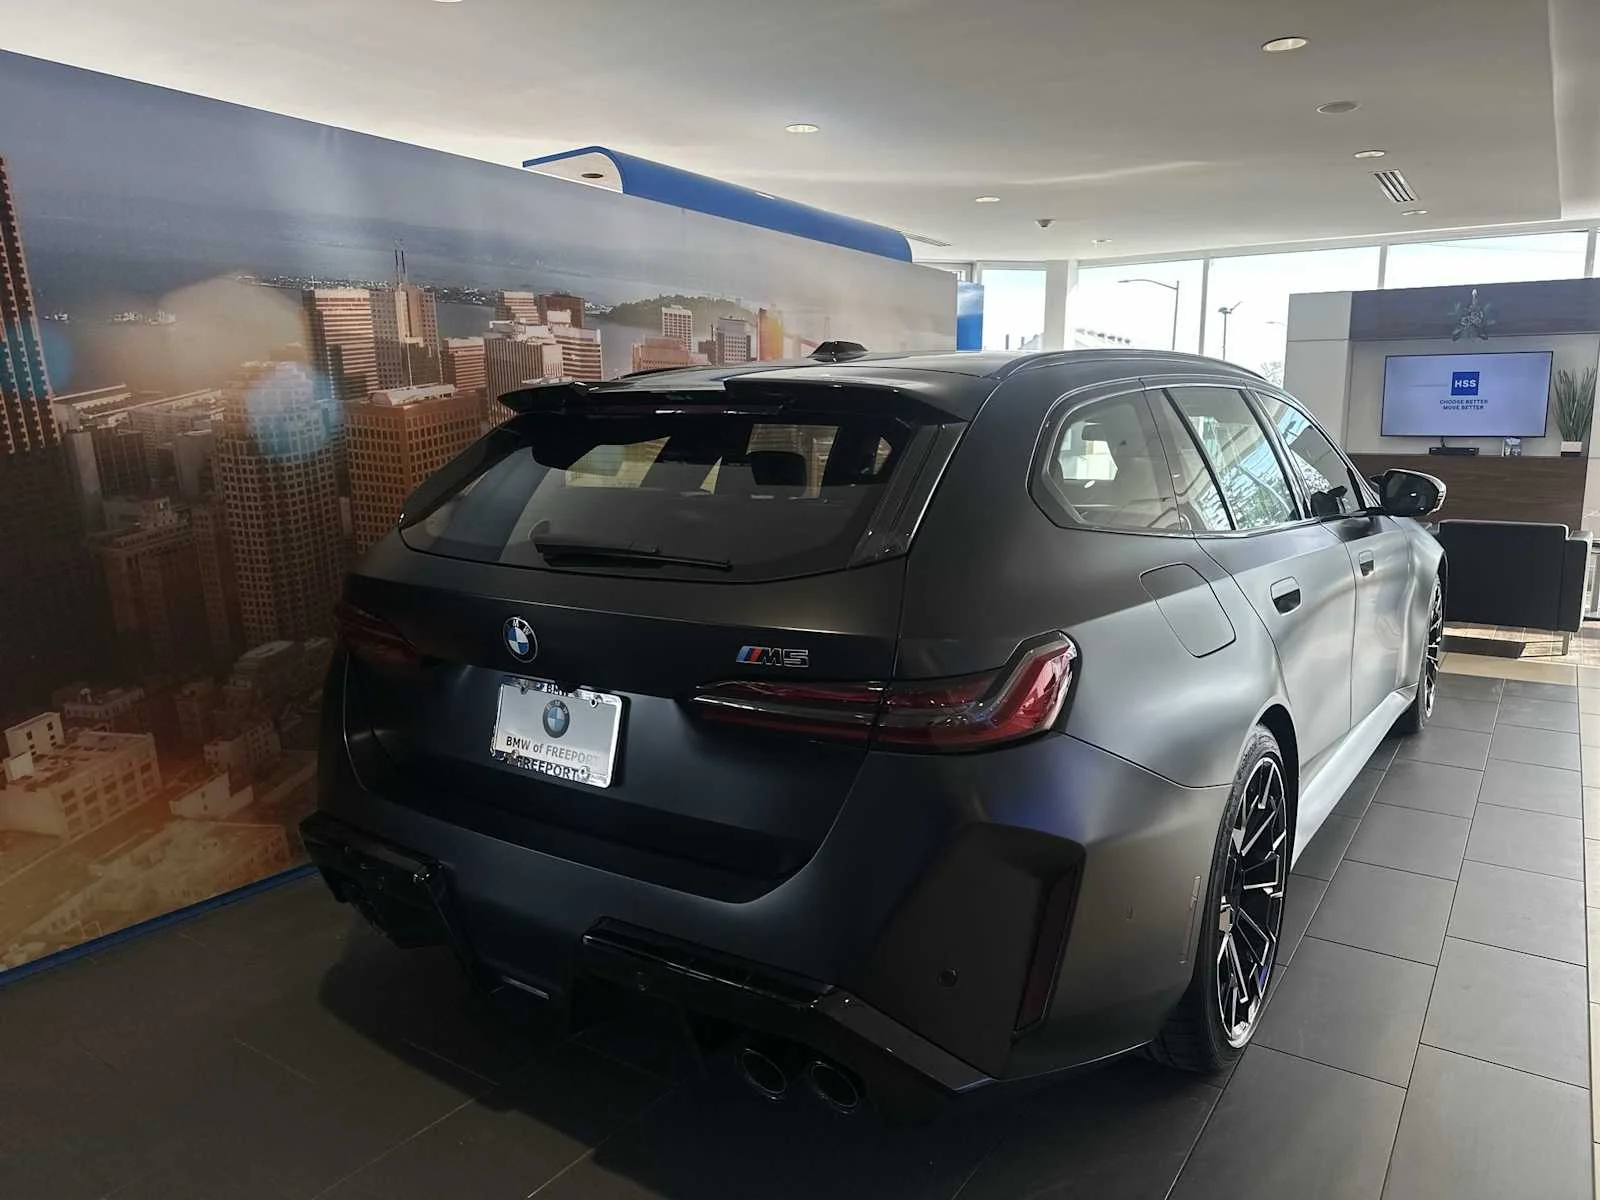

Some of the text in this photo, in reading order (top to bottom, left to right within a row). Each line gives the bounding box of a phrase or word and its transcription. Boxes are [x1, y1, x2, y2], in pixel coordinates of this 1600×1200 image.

[1454, 379, 1477, 388] HSS
[756, 646, 809, 668] M5
[506, 736, 600, 765] BMW of FREEPORT
